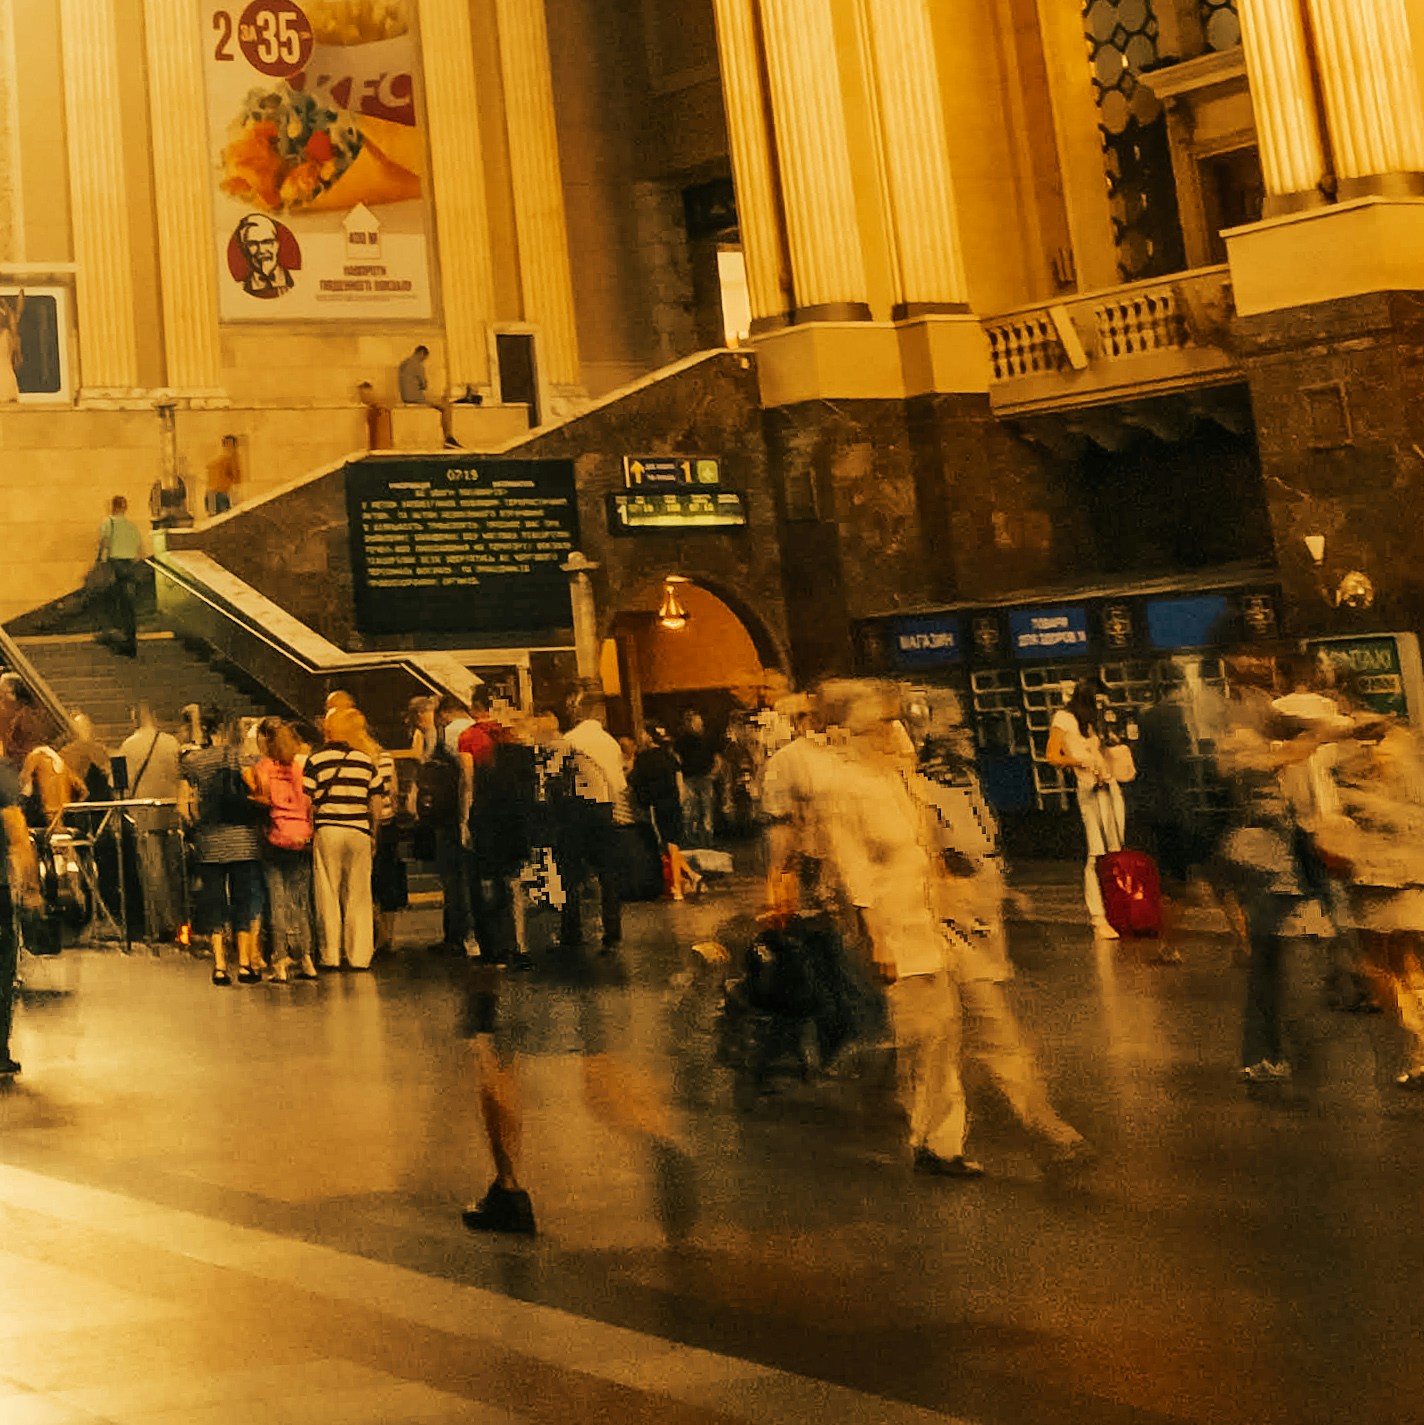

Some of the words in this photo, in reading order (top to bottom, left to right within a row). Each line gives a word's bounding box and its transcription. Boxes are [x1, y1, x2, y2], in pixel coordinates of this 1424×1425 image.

[212, 10, 235, 62] 2
[256, 10, 301, 64] 35
[305, 72, 412, 113] KFC
